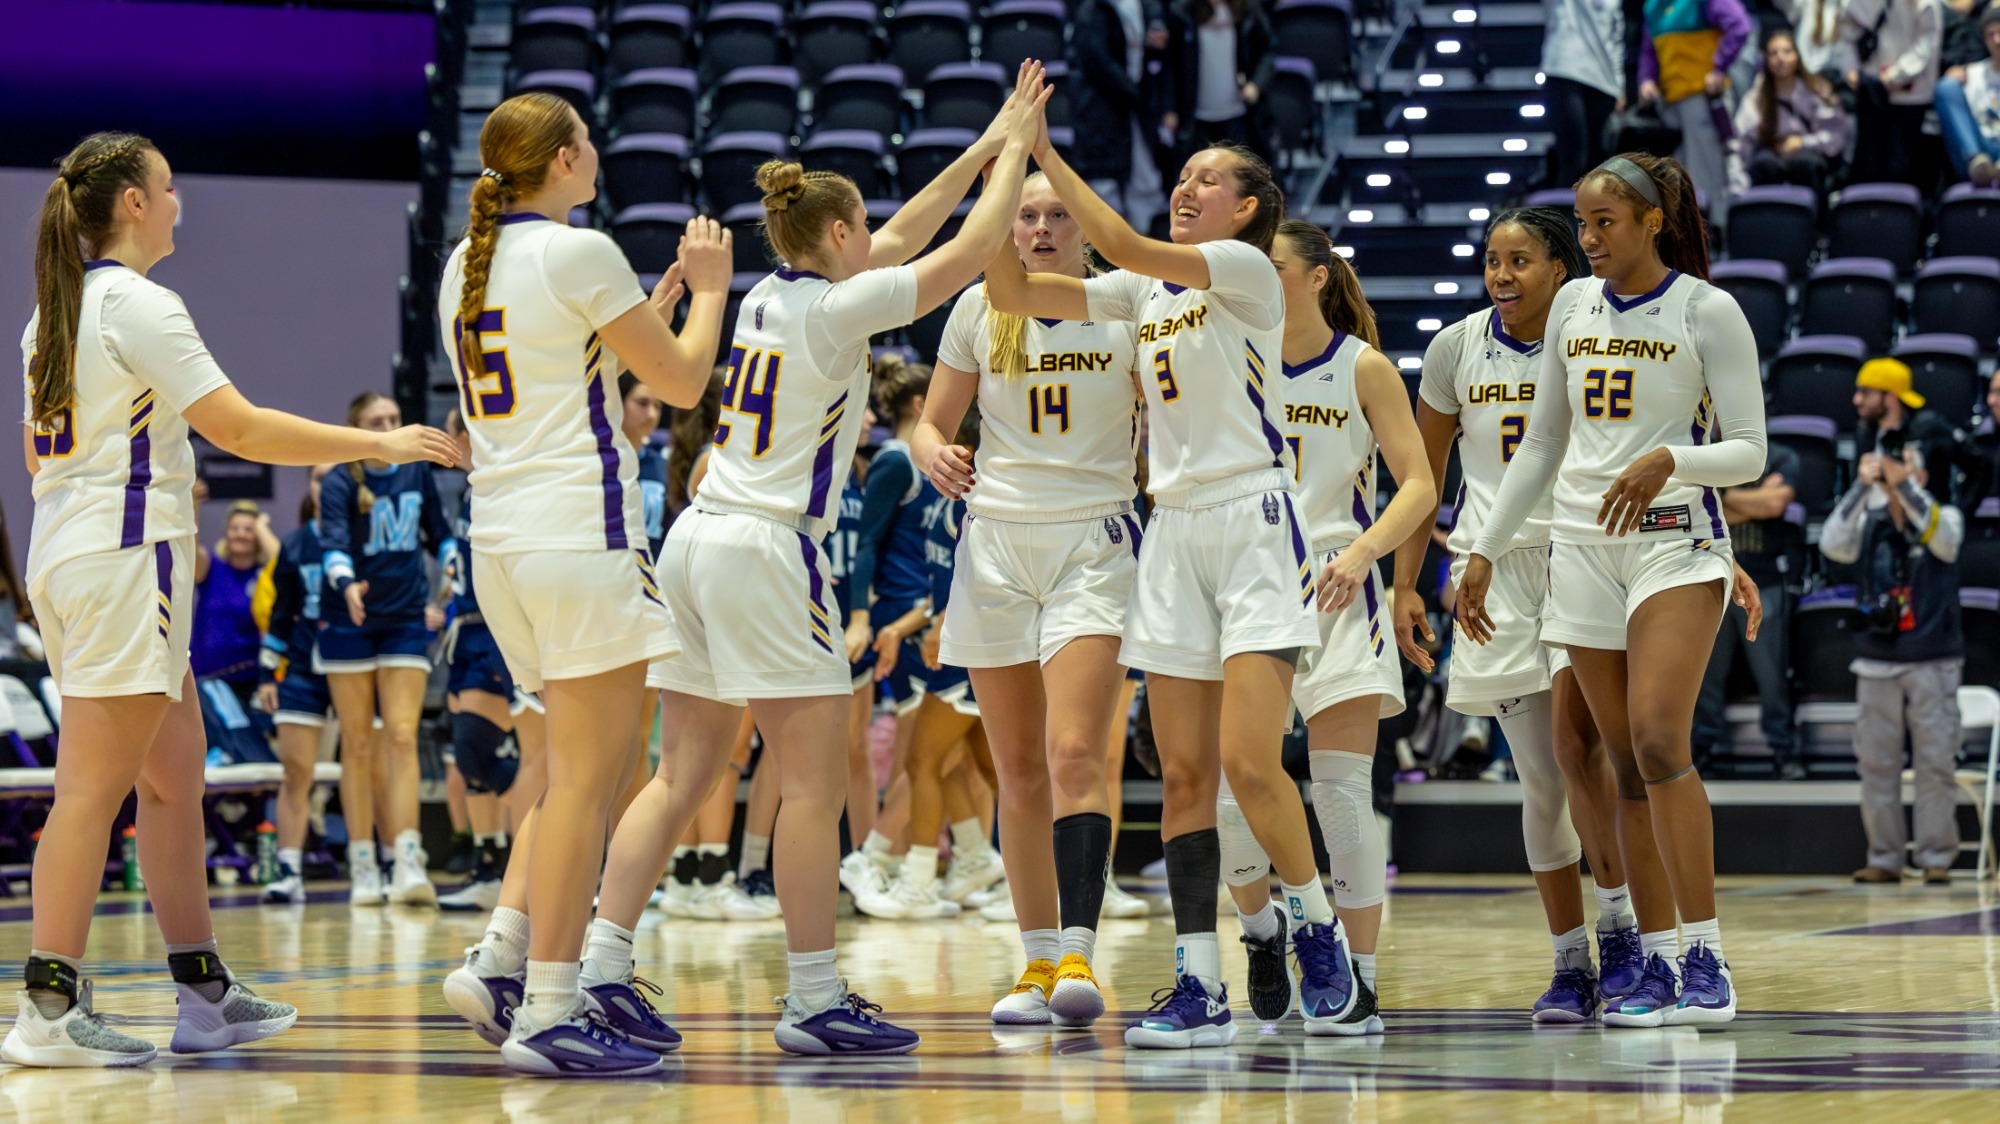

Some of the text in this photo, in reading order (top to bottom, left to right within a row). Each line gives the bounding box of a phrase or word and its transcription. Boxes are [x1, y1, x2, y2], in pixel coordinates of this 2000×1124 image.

[452, 305, 518, 420] 15
[991, 352, 1113, 374] LBANY
[1153, 345, 1181, 404] 3
[1566, 337, 1678, 363] UALBANY
[713, 343, 784, 459] 24
[1027, 383, 1071, 435] 14
[1584, 367, 1636, 420] 22
[363, 490, 424, 556] M
